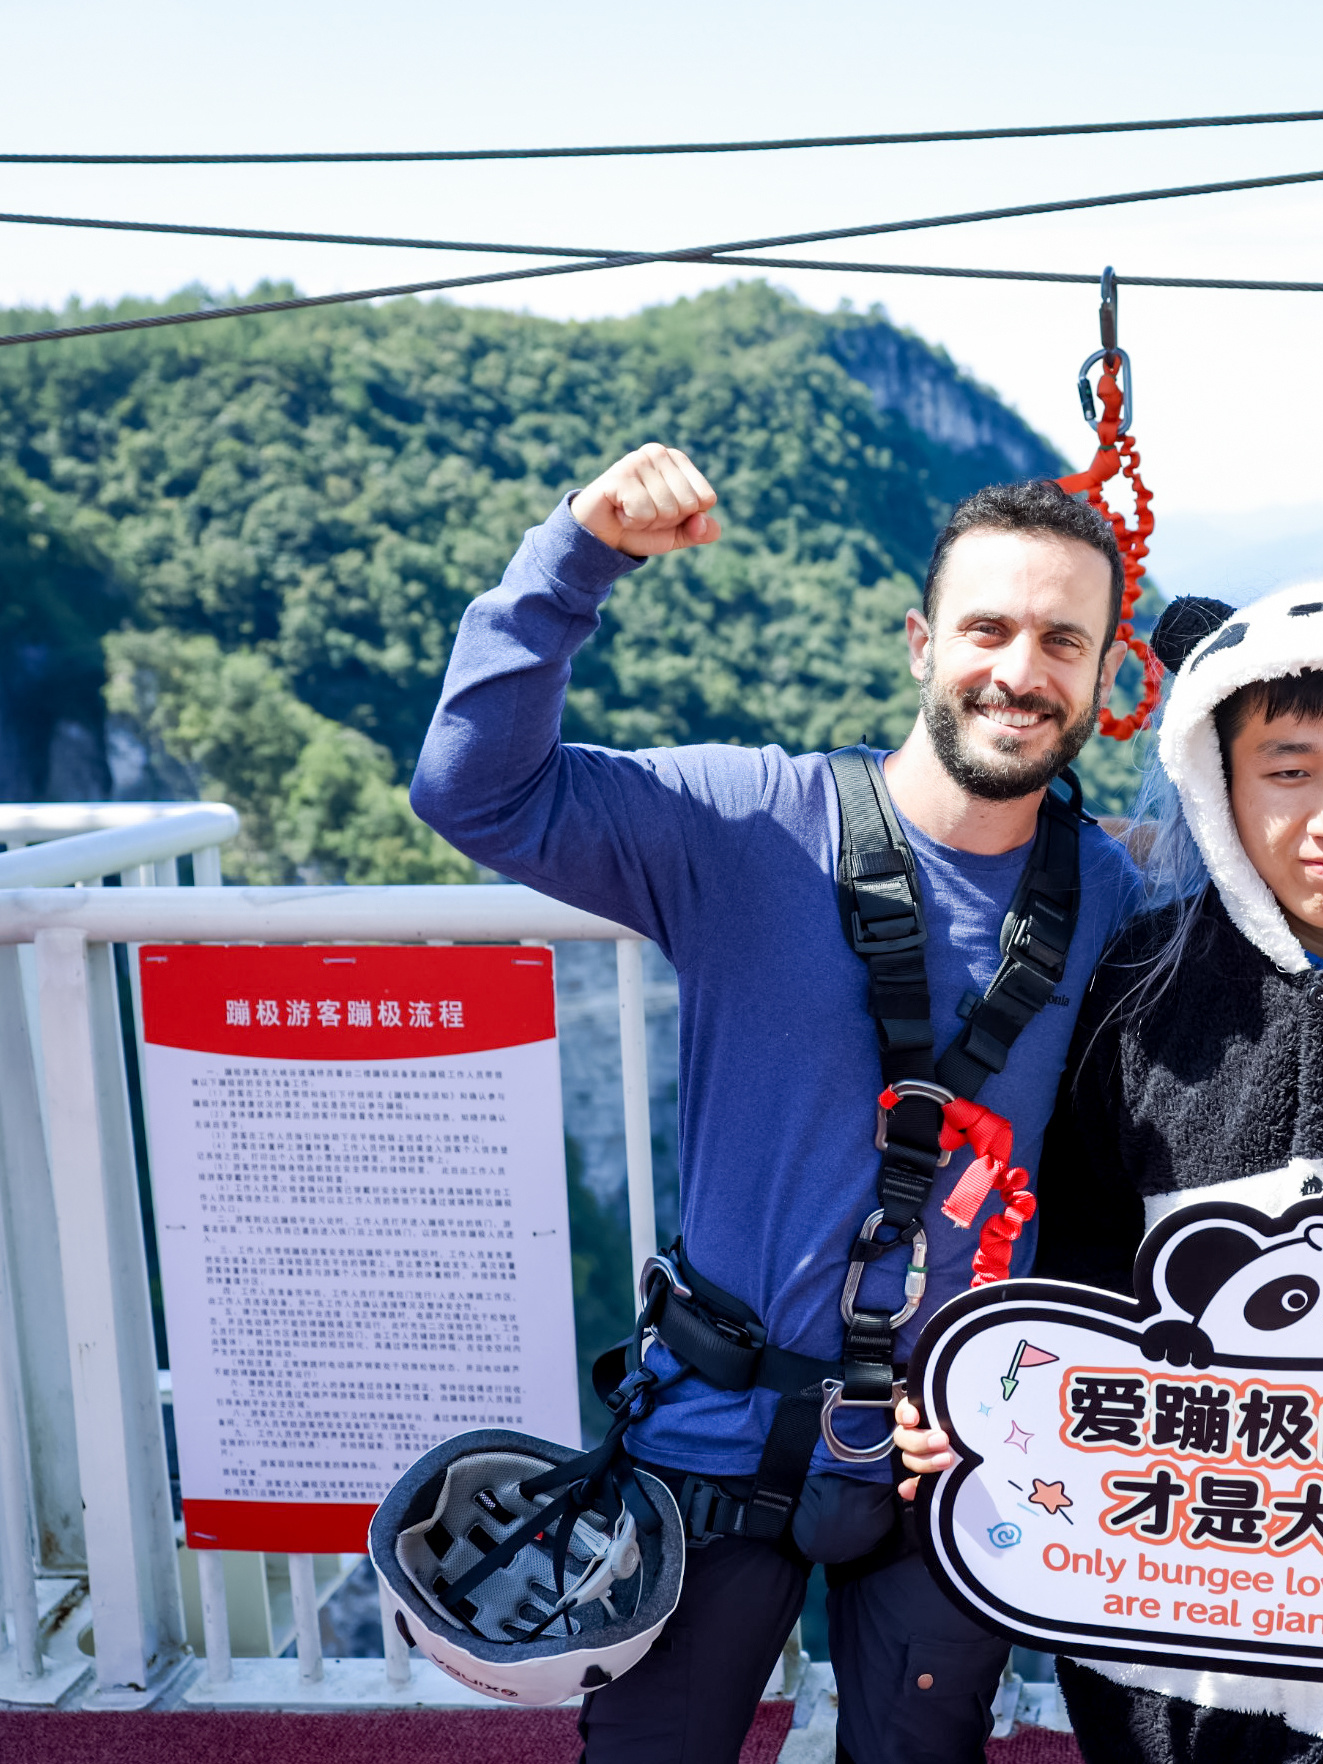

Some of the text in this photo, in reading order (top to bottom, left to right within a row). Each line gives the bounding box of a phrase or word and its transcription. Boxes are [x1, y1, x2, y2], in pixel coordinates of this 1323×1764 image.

[226, 999, 465, 1029] 蹦极游客蹦极流程
[1042, 1543, 1127, 1582] Only
[1138, 1554, 1275, 1594] bungee
[1103, 1593, 1161, 1619] are
[1173, 1598, 1242, 1627] real
